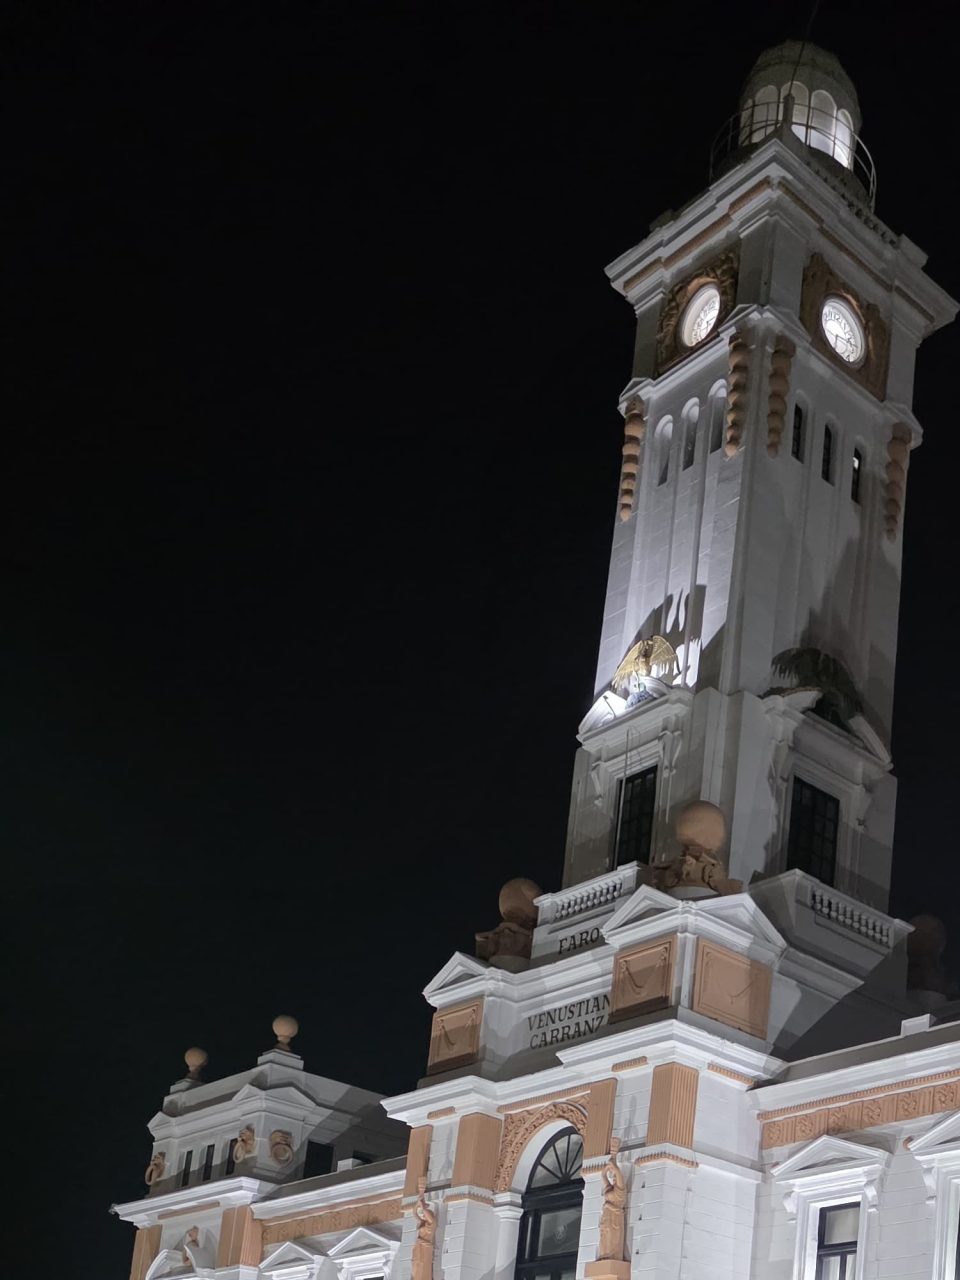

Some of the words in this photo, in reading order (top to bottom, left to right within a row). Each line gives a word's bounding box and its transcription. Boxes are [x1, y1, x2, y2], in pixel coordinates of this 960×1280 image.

[558, 927, 600, 955] FARO
[527, 994, 610, 1031] VENUSTIAN
[529, 1015, 604, 1050] CARRANZ
